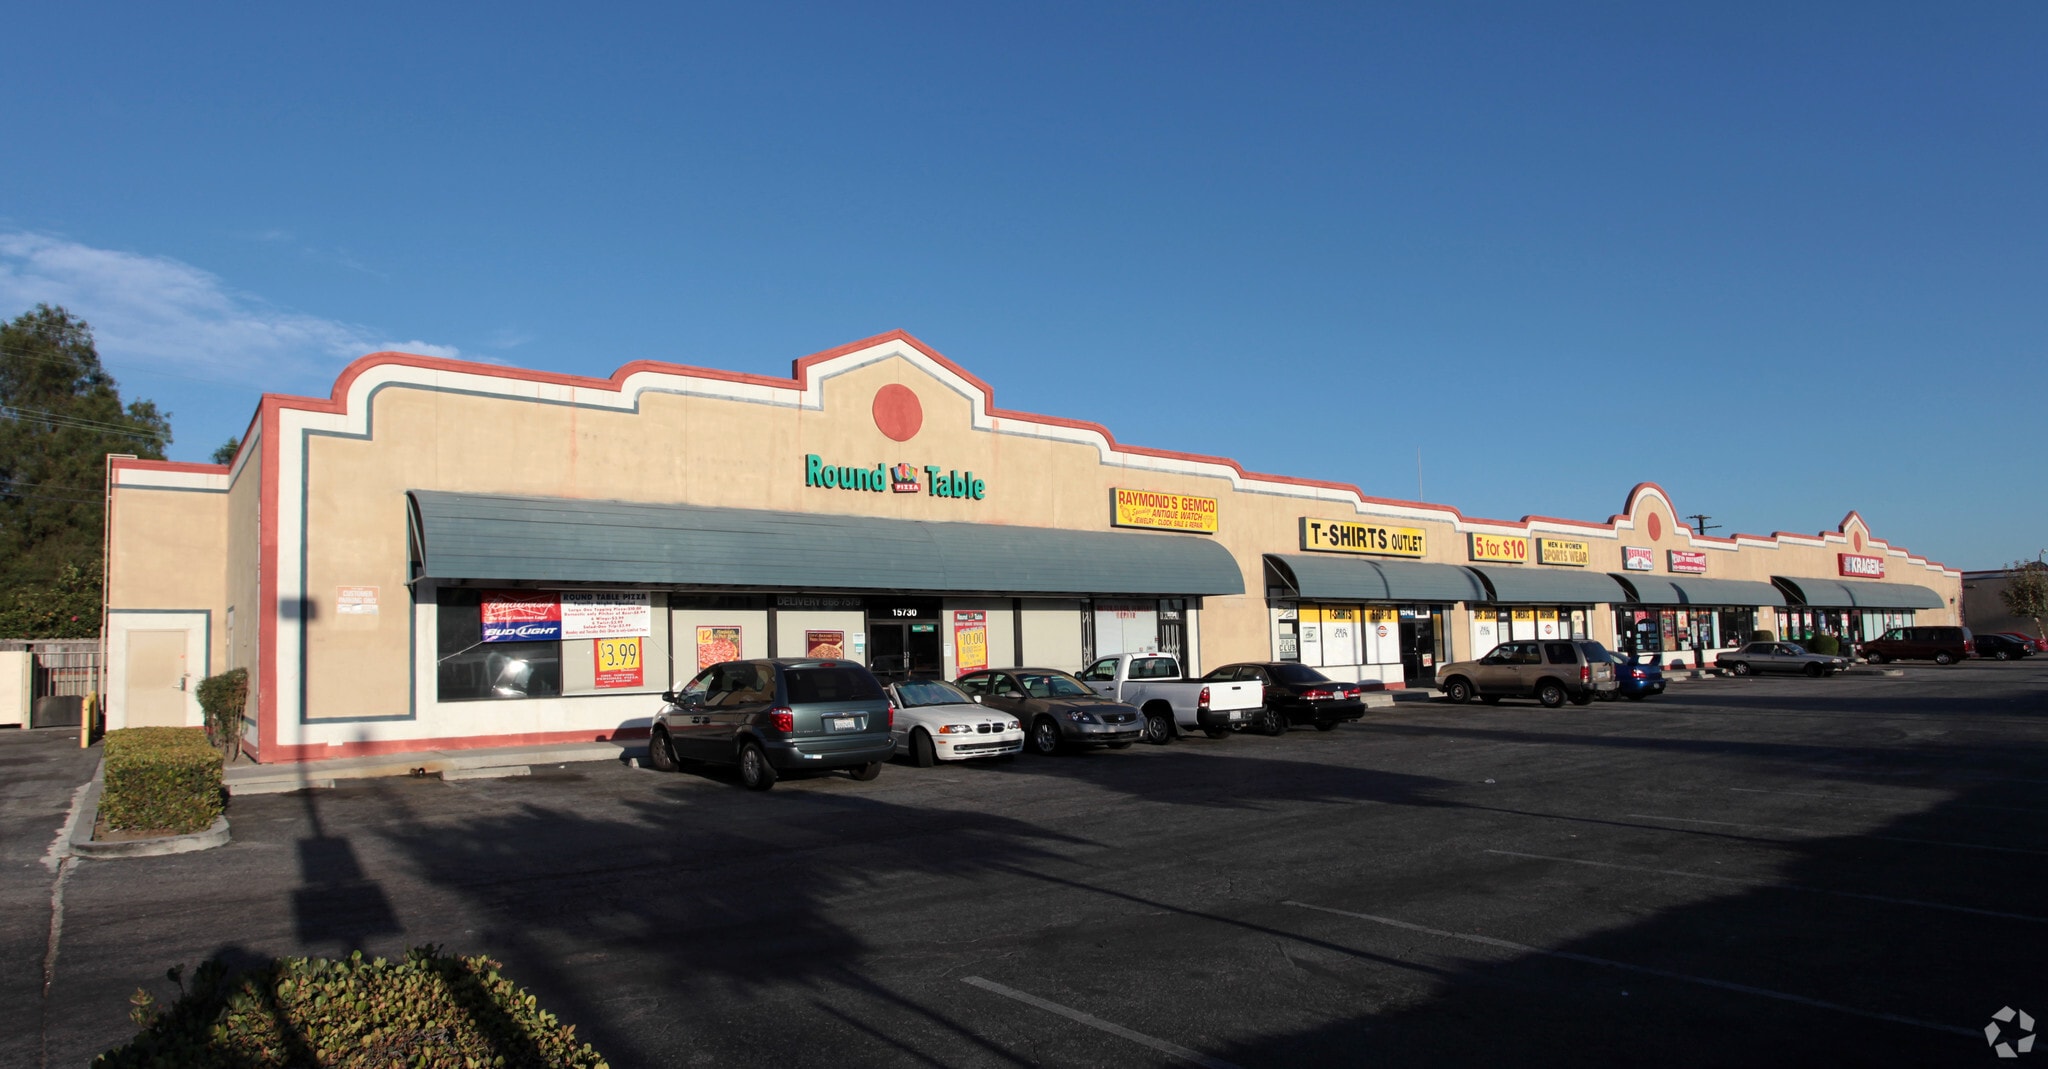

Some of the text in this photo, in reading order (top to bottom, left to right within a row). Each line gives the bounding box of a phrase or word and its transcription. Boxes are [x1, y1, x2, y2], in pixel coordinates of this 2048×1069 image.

[805, 454, 985, 500] Round Table
[1118, 491, 1215, 513] RAYMOND'S GEMCO
[1152, 509, 1178, 519] ANTIQUE
[1180, 512, 1203, 521] WATCH
[1311, 522, 1422, 552] T-SHIRTS OUTLET
[1476, 537, 1525, 559] 5 for $10
[1544, 549, 1587, 563] SPORTS WEAR
[1627, 549, 1652, 563] INSURANCE
[1852, 557, 1879, 575] KRAGEN
[563, 593, 593, 601] ROUND
[777, 596, 820, 606] DELIVERY
[892, 608, 917, 617] 15730
[484, 627, 558, 636] BUD LIGHT
[600, 642, 637, 666] $3.99
